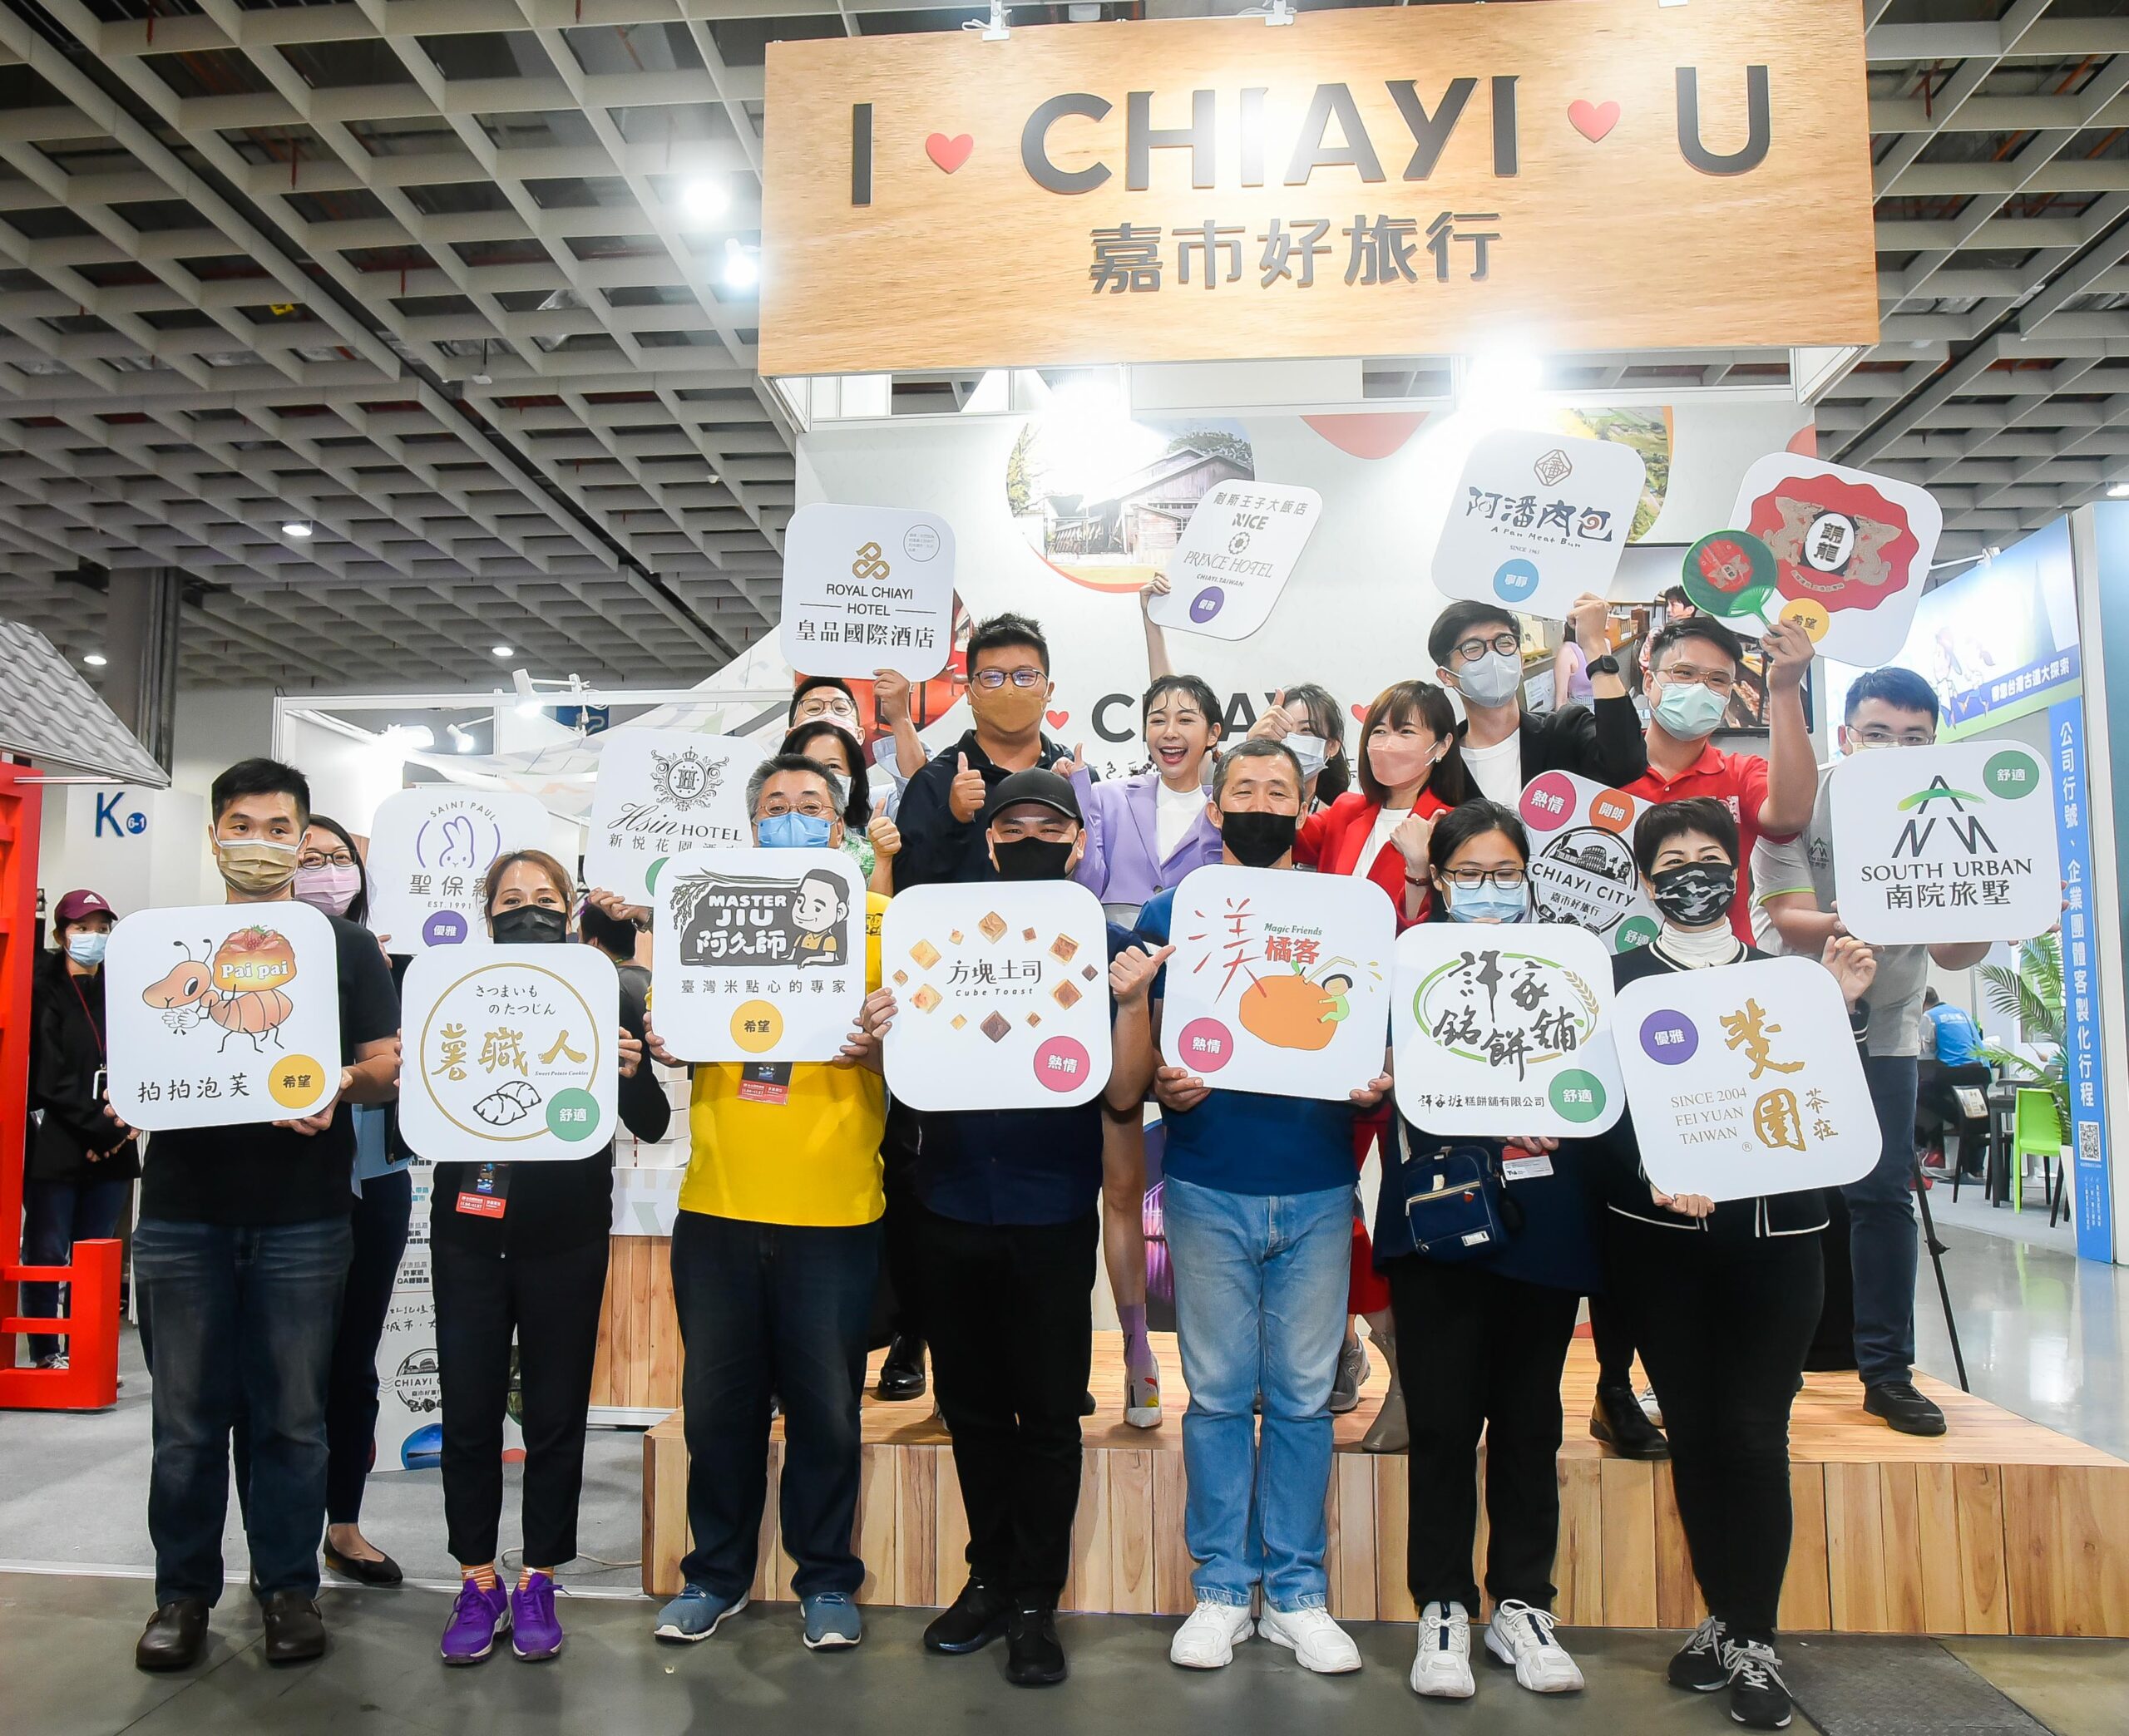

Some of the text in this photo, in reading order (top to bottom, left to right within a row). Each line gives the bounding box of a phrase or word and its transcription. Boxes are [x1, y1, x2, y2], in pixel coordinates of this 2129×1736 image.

[850, 64, 1771, 207] I CHIAYI U
[1087, 210, 1503, 293] 嘉市好旅行
[1213, 491, 1309, 516] 耐斯王子大飯店
[1232, 512, 1270, 530] NICE
[1465, 486, 1613, 543] 阿潘肉包
[1504, 528, 1523, 538] Pan
[1528, 532, 1556, 544] Meat
[1559, 537, 1582, 549] Bun
[1183, 550, 1275, 579] PRINCE HOTEL
[826, 583, 914, 600] ROYAL CHIAYI
[847, 602, 891, 617] HOTEL
[795, 619, 935, 649] 皇品國際酒店
[1997, 767, 2026, 782] 舒適
[429, 800, 496, 821] SAINT PAUL
[1530, 789, 1565, 816] 熱情
[1598, 801, 1626, 822] 開朗
[95, 791, 126, 838] K
[607, 802, 743, 842] Hsin HOTEL
[1860, 857, 2033, 882] SOUTH URBAN
[1531, 862, 1637, 908] CHIAYI CITY
[1885, 879, 2012, 910] 南院旅墅
[709, 895, 787, 908] MASTER
[1549, 891, 1603, 917] 嘉市好旅行
[715, 909, 773, 927] JIU
[433, 924, 457, 937] 優雅
[1263, 922, 1322, 936] Magic Friends
[696, 929, 787, 960] 阿久師
[220, 960, 289, 980] Pai pai
[946, 958, 1042, 985] 方塊土司
[476, 984, 538, 998] さつまいも
[680, 979, 847, 994] 臺灣米點心的專家
[956, 988, 1034, 997] Cube Toast
[743, 1019, 770, 1033] 希望
[1192, 1036, 1222, 1054] 熱情
[1653, 1028, 1685, 1047] 優雅
[1047, 1053, 1078, 1074] 熱情
[136, 1072, 251, 1104] 拍拍泡芙
[282, 1074, 312, 1089] 希望
[1562, 1088, 1593, 1104] 舒適
[1670, 1086, 1748, 1109] SINCE 2004
[558, 1107, 587, 1122] 舒適
[1674, 1106, 1745, 1127] FEI YUAN
[1679, 1126, 1739, 1146] TAIWAN
[394, 1378, 432, 1388] CHIAYI
